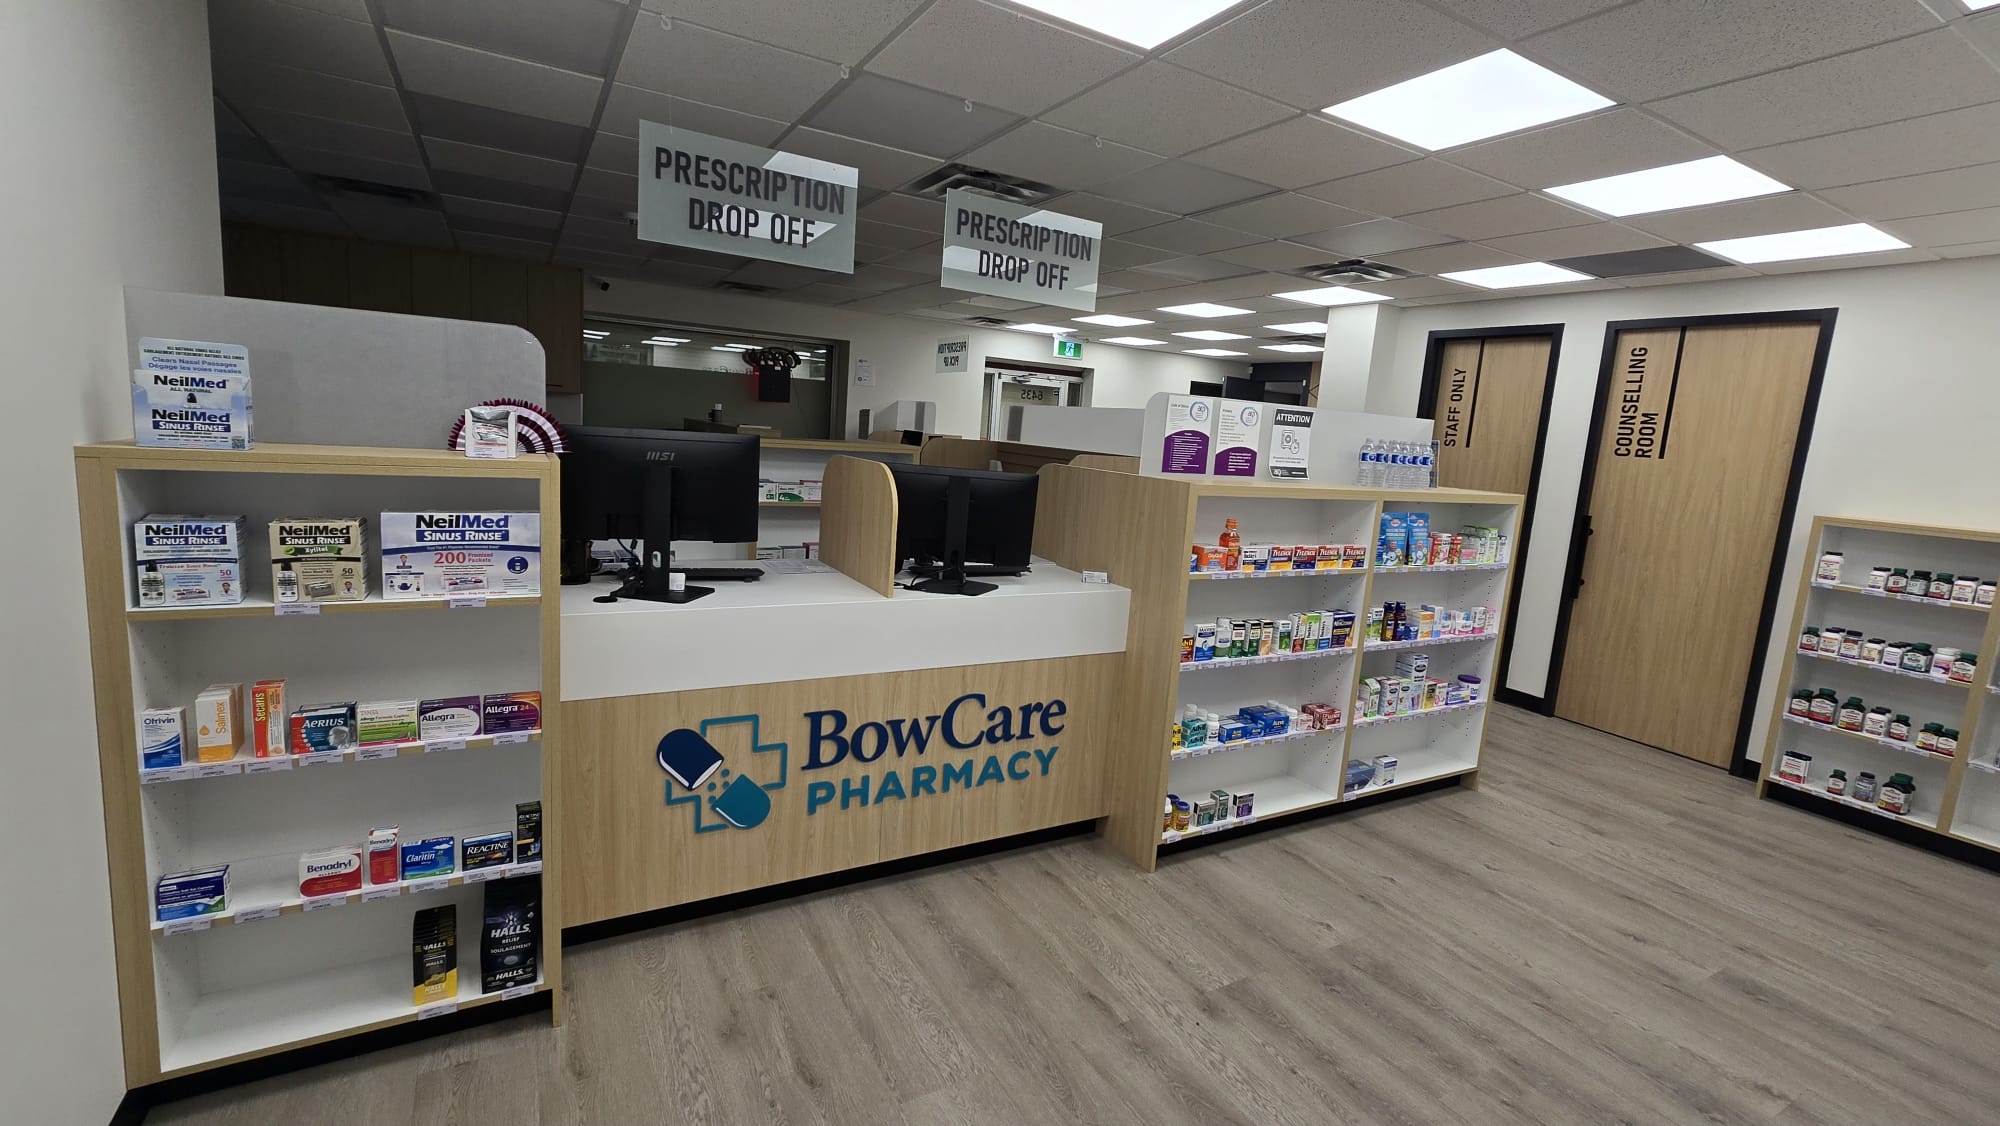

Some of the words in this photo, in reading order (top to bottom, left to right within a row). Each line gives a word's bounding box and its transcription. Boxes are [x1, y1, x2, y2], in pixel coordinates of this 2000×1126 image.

[655, 146, 845, 215] PRESCRIPTION
[689, 197, 760, 239] DROP
[770, 212, 816, 249] OFF
[956, 208, 1092, 262] PRESCRIPTION
[978, 249, 1030, 285] DROP
[1036, 260, 1070, 291] OFF
[154, 375, 227, 389] NeilMed
[1451, 368, 1467, 402] ONLY
[1614, 347, 1648, 457] COUNSELLING
[152, 409, 230, 422] NeilMed
[1276, 413, 1311, 424] ATTENTION
[159, 421, 191, 431] SINUS
[194, 422, 225, 432] RINSE
[1444, 406, 1462, 448] STAFF
[1635, 413, 1659, 458] ROOM
[416, 515, 509, 529] NeilMed
[145, 524, 227, 536] NeilMed
[279, 525, 350, 536] NeilMed
[424, 531, 461, 541] SINUS
[465, 531, 502, 540] RINSE
[152, 537, 185, 545] SINUS
[188, 536, 221, 544] RINSE
[286, 537, 314, 545] SINUS
[316, 536, 345, 545] RINSE
[434, 552, 466, 564] 200
[255, 692, 265, 722] Secaris
[485, 704, 518, 714] Allegra
[144, 717, 175, 725] Otrivin
[216, 701, 226, 734] Salinex
[421, 713, 455, 723] Allegra
[801, 693, 1067, 771] BowCare
[807, 746, 1060, 816] PHARMACY
[467, 841, 509, 854] REACTINE
[406, 853, 435, 863] Claritin
[307, 859, 352, 874] Benadryl
[490, 923, 531, 938] HALLS
[502, 936, 520, 944] RELIEF
[495, 968, 524, 980] HALLS
